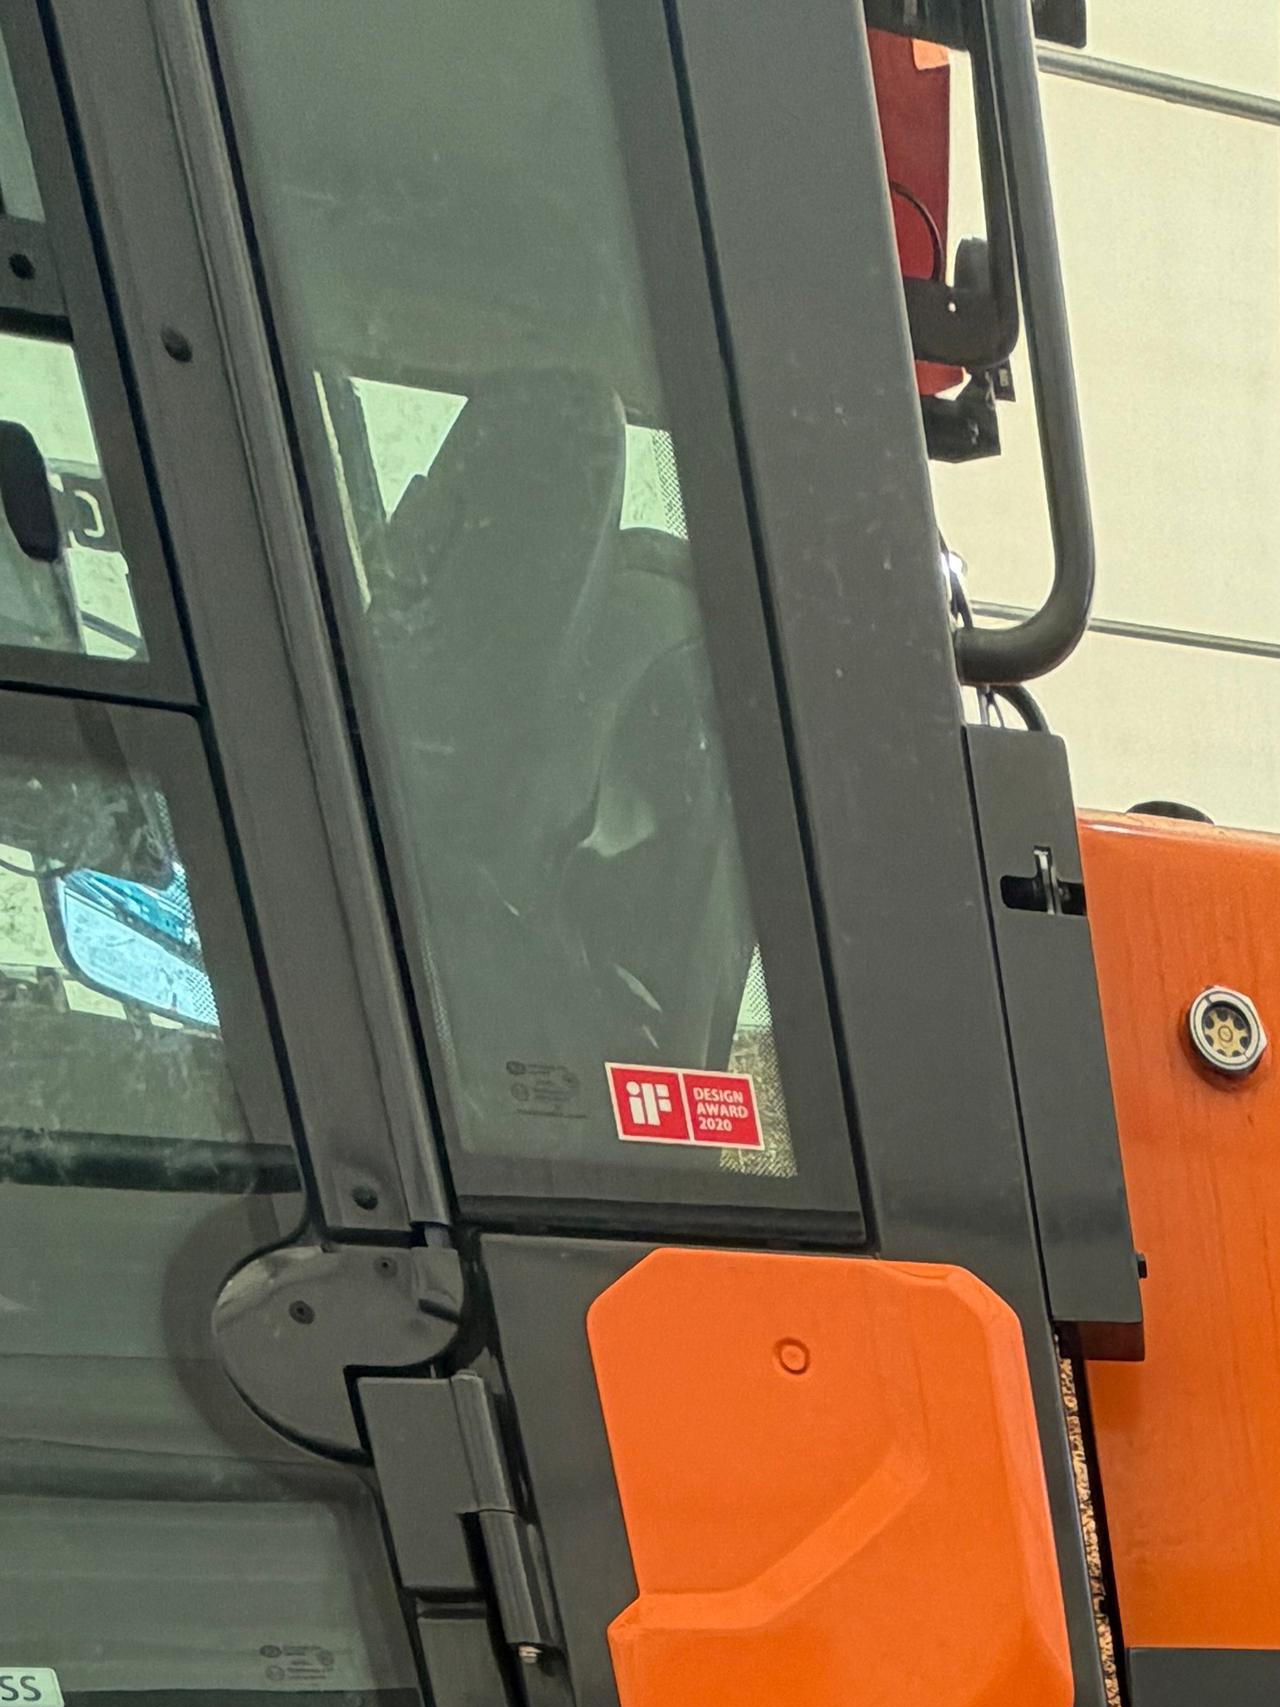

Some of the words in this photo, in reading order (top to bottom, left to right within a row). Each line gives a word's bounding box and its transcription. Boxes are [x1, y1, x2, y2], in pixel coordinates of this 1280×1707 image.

[693, 1087, 743, 1104] DESIGN
[696, 1103, 749, 1119] AWARD
[699, 1117, 732, 1132] 2020
